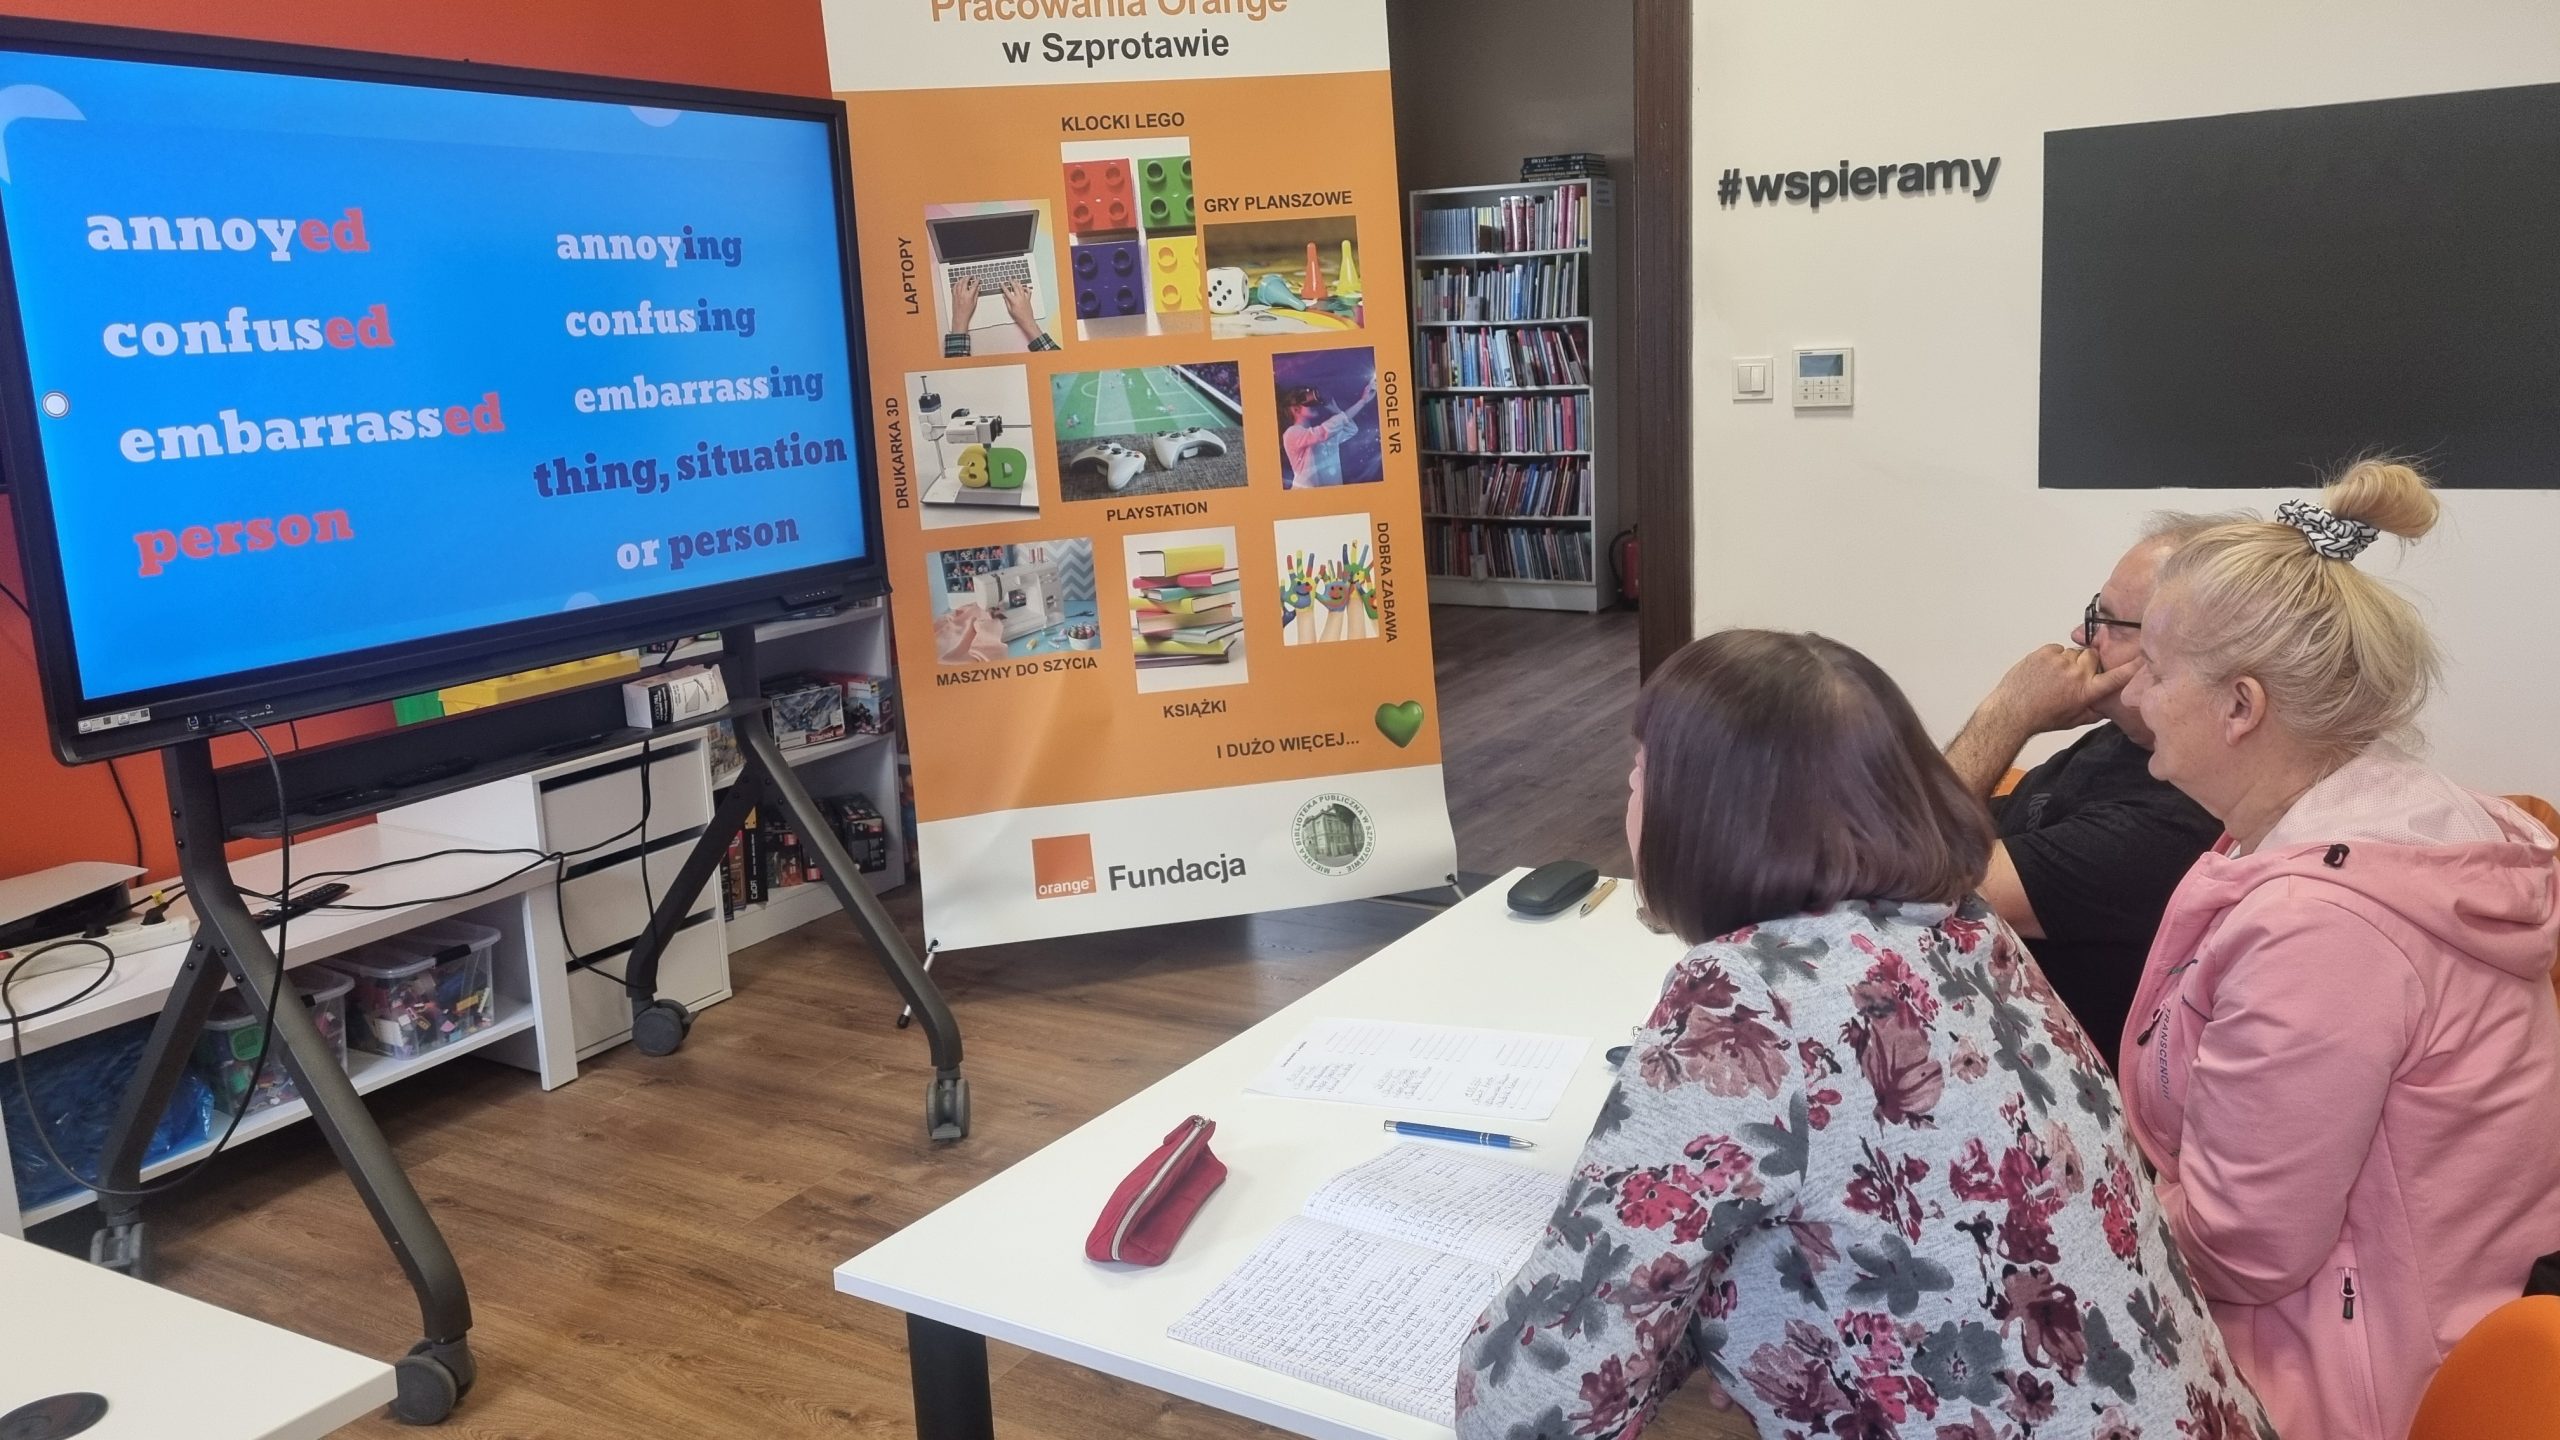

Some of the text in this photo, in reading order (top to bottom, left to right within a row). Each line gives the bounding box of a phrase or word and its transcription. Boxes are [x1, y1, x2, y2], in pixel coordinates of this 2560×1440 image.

[1158, 0, 1288, 21] Orange
[1003, 26, 1230, 68] w Szprotawie
[1061, 112, 1185, 132] KLOCKI LEGO
[1204, 190, 1353, 214] GRY PLANSZOWE
[1717, 156, 2001, 208] #wspieramy
[86, 208, 370, 263] annoyed
[557, 226, 743, 268] annoying
[902, 236, 919, 315] LAPTOPY
[103, 306, 394, 358] confused
[566, 299, 757, 339] confusing
[575, 366, 824, 414] embarrassing
[1384, 371, 1401, 454] GOGLE VR
[119, 392, 506, 463] embarrassed
[533, 433, 848, 499] thing, situation
[885, 397, 909, 509] DRUKARKA 3D
[957, 444, 1027, 489] 3D
[1106, 502, 1208, 521] PLAYSTATION
[133, 508, 354, 577] person
[617, 514, 800, 570] or person
[1377, 522, 1397, 643] DOBRA ZABAWA
[936, 657, 1097, 686] MASZYNY DO SZYCIA
[1163, 699, 1227, 718] KSIĄŻKI
[1216, 731, 1360, 759] I DUŻO WIĘCEJ...
[1294, 794, 1373, 875] MIEJSKA BIBLIOTEKA PUBLICZNA W SZPROTAWIE
[1108, 852, 1247, 892] Fundacja
